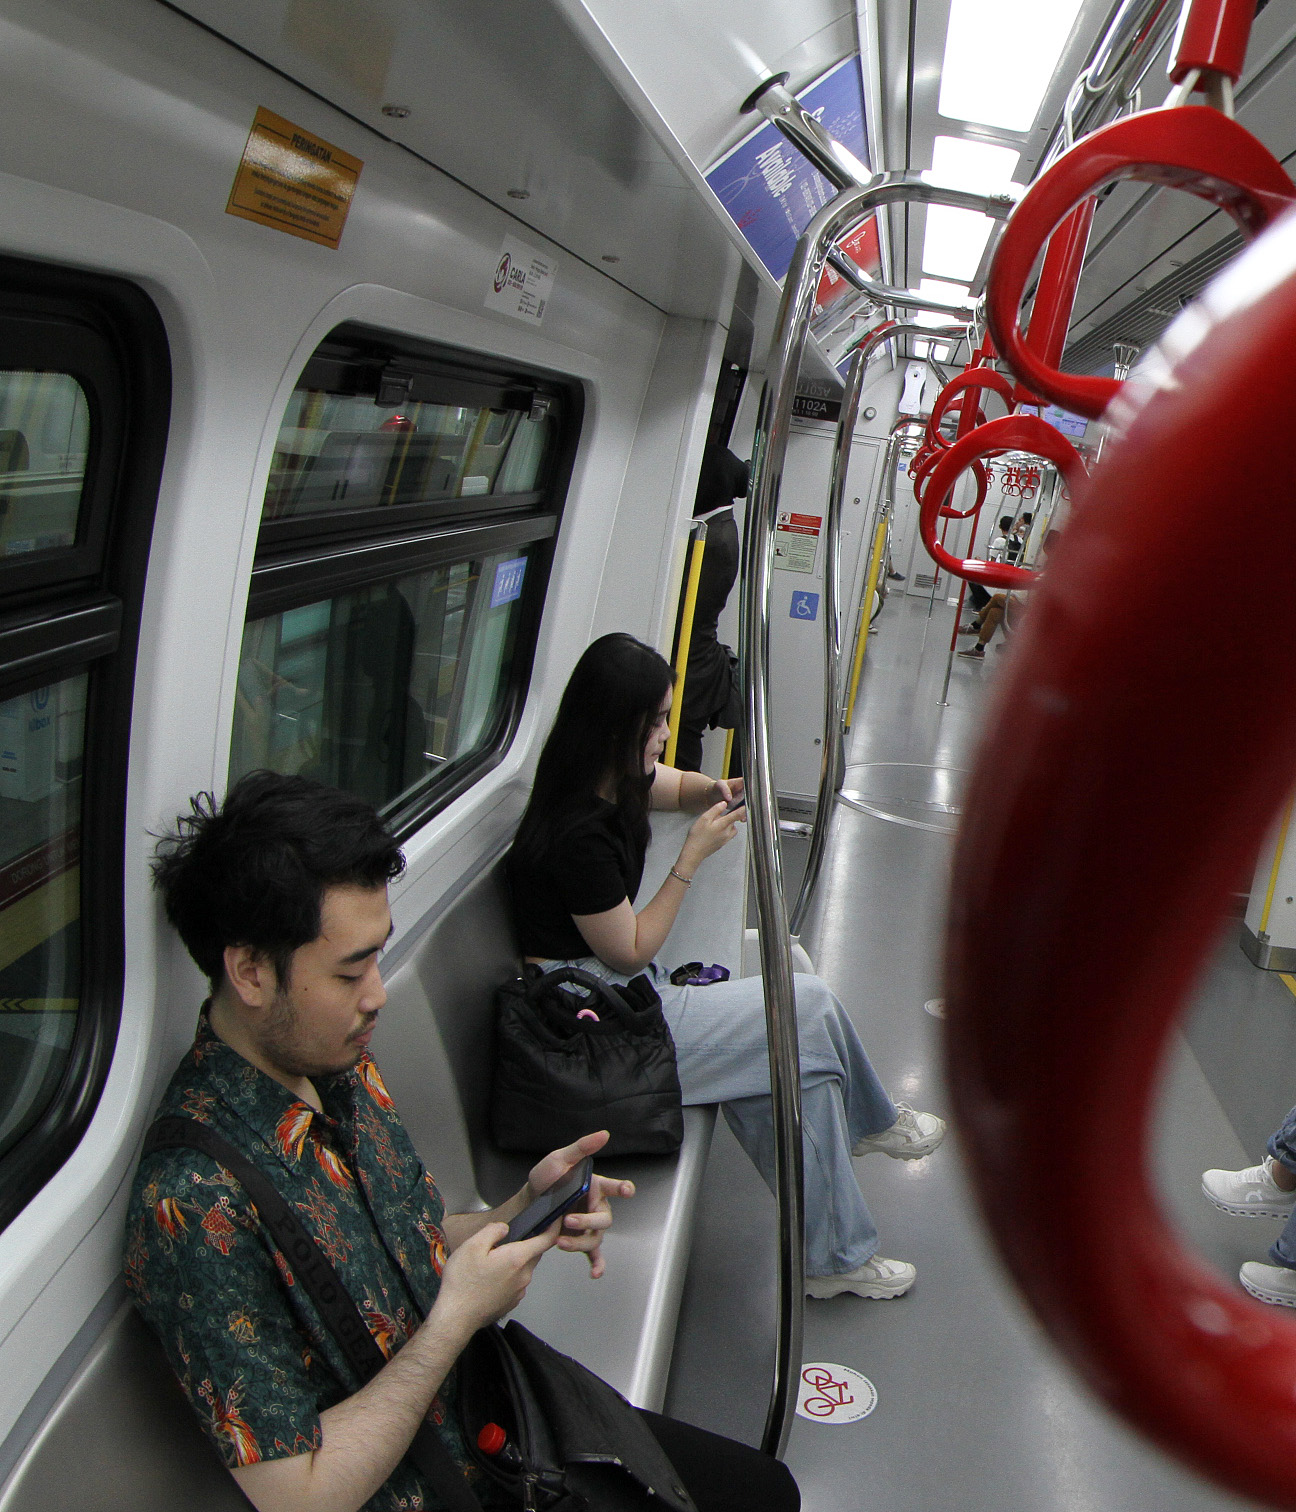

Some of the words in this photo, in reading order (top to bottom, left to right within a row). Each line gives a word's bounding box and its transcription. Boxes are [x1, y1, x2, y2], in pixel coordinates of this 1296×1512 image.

[291, 133, 332, 163] PERINGATAN
[756, 142, 796, 198] Available
[510, 267, 526, 284] CARLA
[796, 398, 827, 412] 1102A
[275, 1213, 338, 1304] POLO
